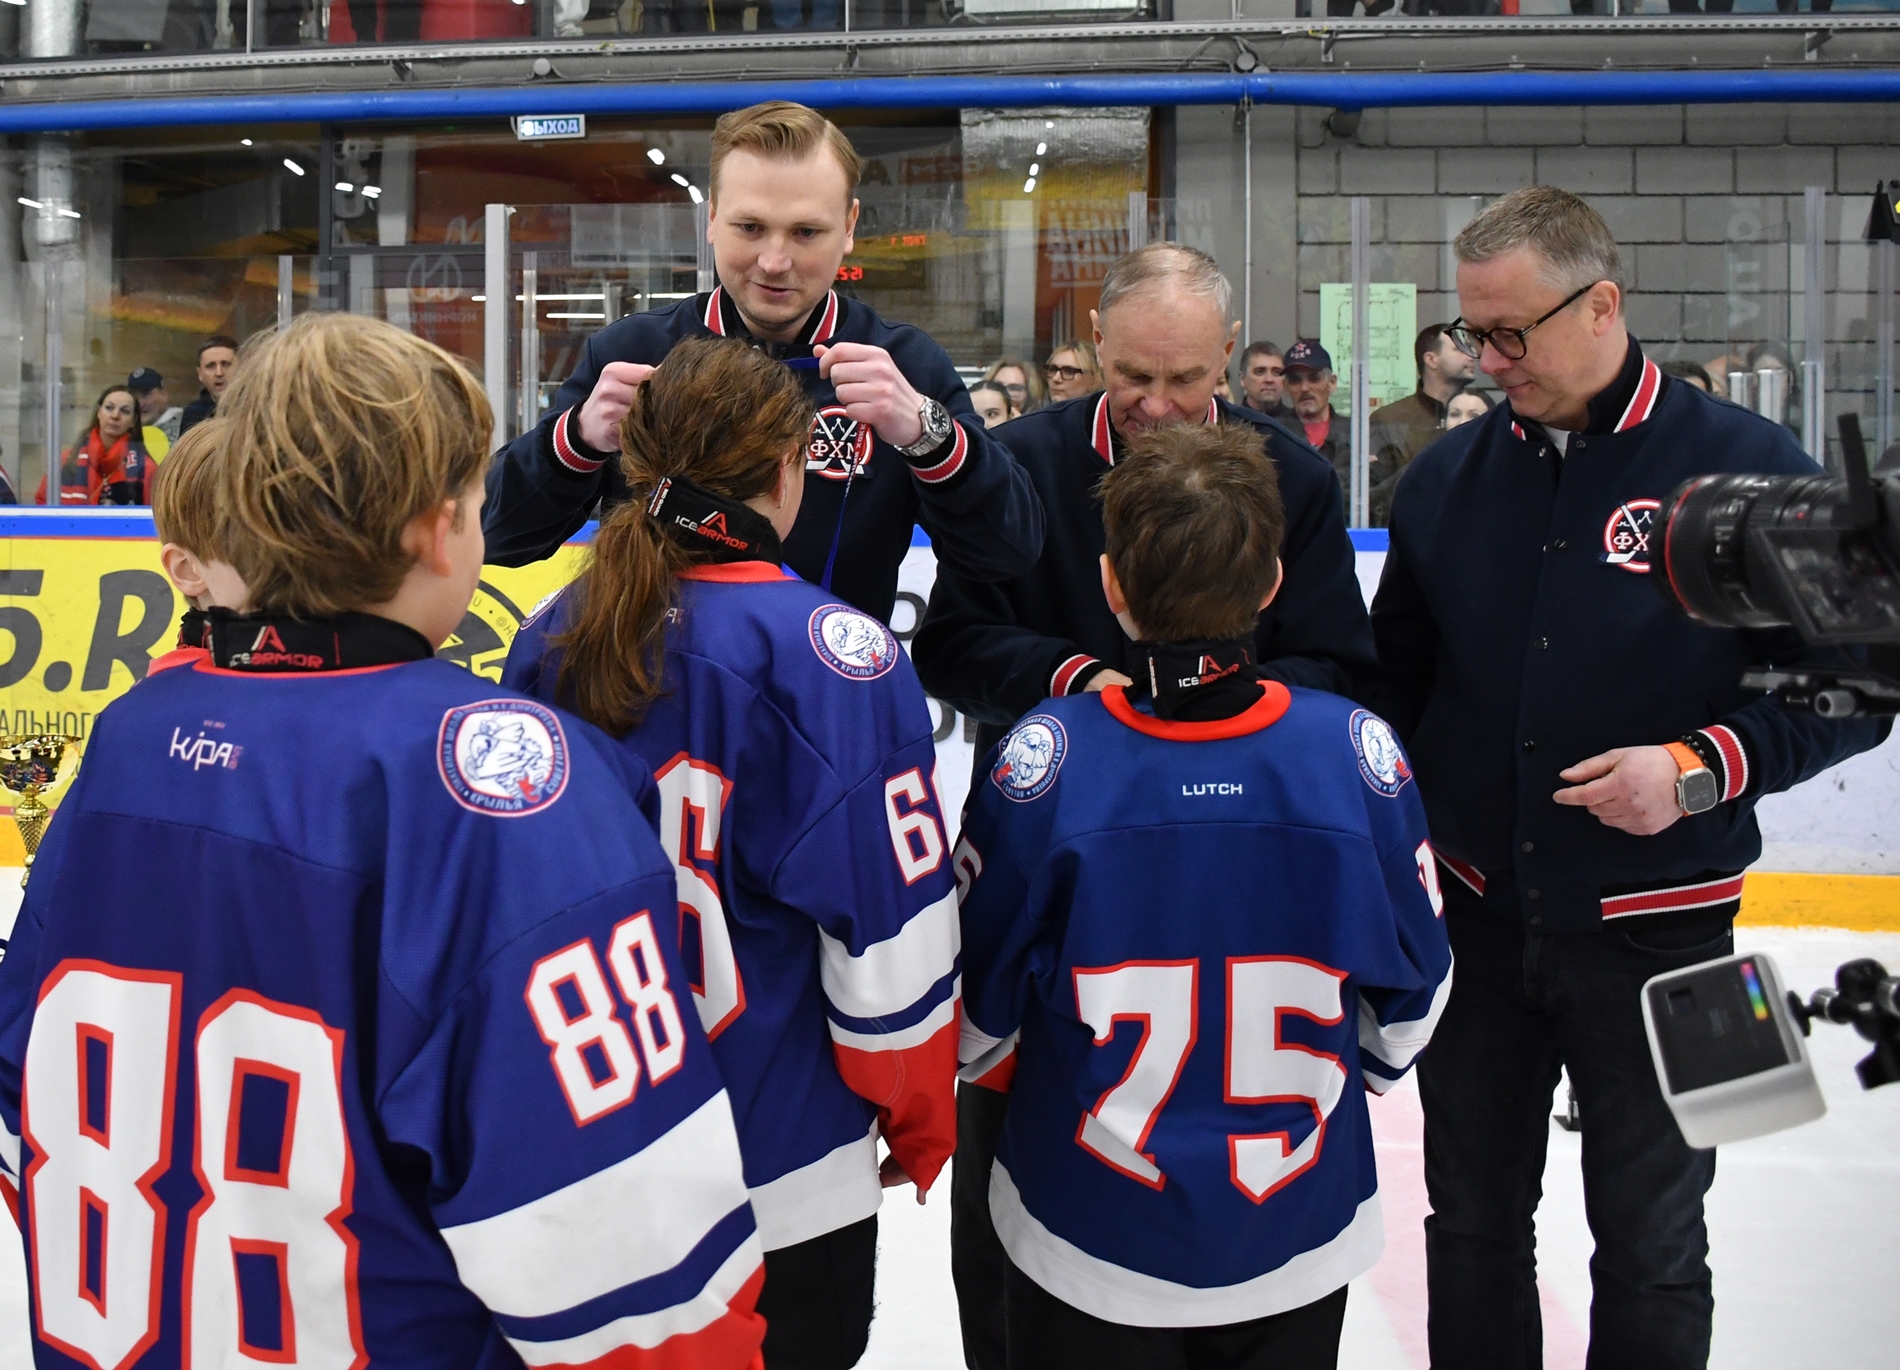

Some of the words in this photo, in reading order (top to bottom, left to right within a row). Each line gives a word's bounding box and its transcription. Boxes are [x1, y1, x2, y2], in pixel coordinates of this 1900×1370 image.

[1181, 782, 1244, 797] LUTCH
[523, 908, 687, 1129] 88
[1071, 954, 1350, 1206] 75
[20, 957, 371, 1370] 88
